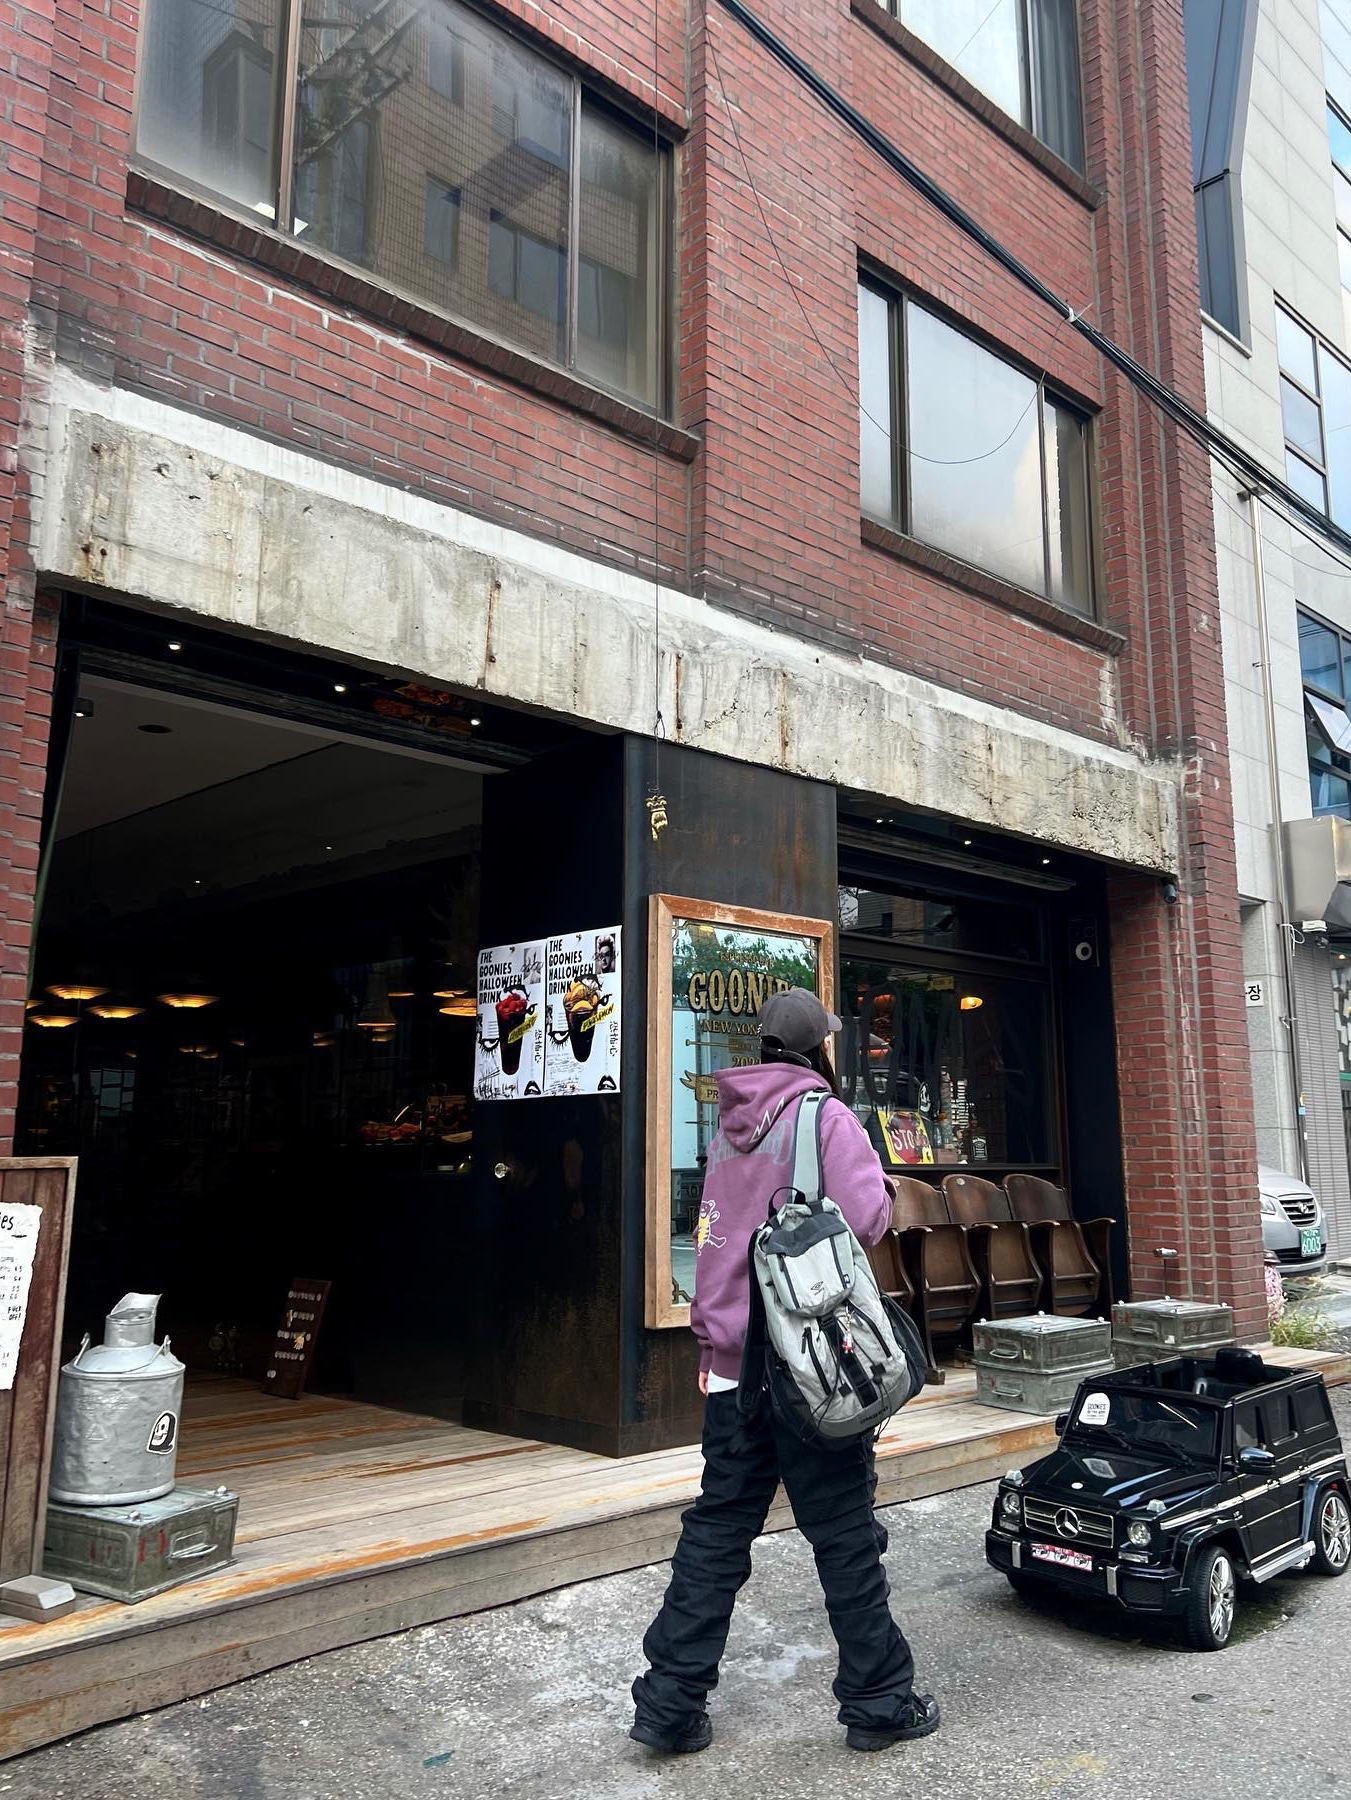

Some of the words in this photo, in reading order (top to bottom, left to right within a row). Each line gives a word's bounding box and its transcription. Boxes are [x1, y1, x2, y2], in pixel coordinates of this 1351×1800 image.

[549, 939, 563, 953] THE
[480, 951, 493, 965] THE
[549, 950, 583, 967] GOONIES
[480, 962, 512, 978] GOONIES
[548, 962, 594, 981] HALLOWEEN
[479, 973, 523, 991] HALLOWEEN
[548, 979, 572, 996] DRINK
[478, 990, 502, 1005] DRINK
[687, 967, 802, 1017] GOONI
[1245, 984, 1262, 1001] 장
[702, 1019, 733, 1034] NEW
[706, 1088, 719, 1099] PR
[892, 1127, 920, 1152] STO
[0, 1211, 14, 1231] es
[1301, 1236, 1321, 1257] 6003
